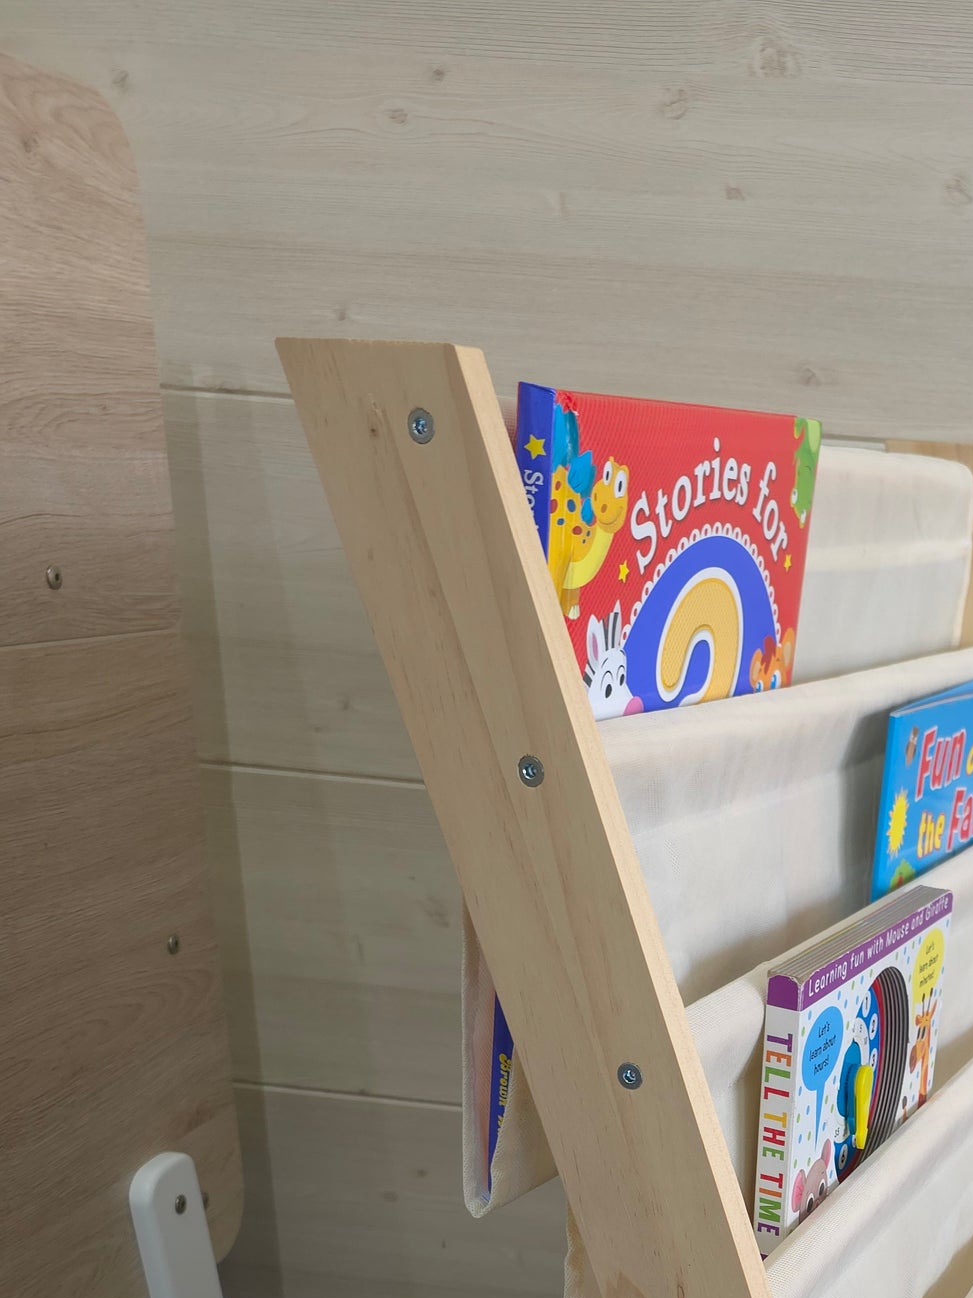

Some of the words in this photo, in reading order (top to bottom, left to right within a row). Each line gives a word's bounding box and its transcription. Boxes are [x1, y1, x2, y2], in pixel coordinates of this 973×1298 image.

[630, 436, 751, 575] Stories
[752, 461, 789, 562] for
[915, 725, 967, 802] Fun
[917, 809, 946, 859] the
[808, 960, 848, 997] Learning
[850, 951, 865, 970] fun
[866, 936, 884, 960] with
[885, 922, 909, 947] Mouse
[910, 909, 925, 931] and
[925, 895, 949, 921] Giraffe
[809, 1046, 823, 1062] learn
[822, 1034, 837, 1052] about
[818, 1021, 831, 1038] Let's
[870, 1019, 876, 1034] 2
[763, 1033, 793, 1100] TELL
[762, 1112, 787, 1161] THE
[757, 1172, 784, 1237] TIME
